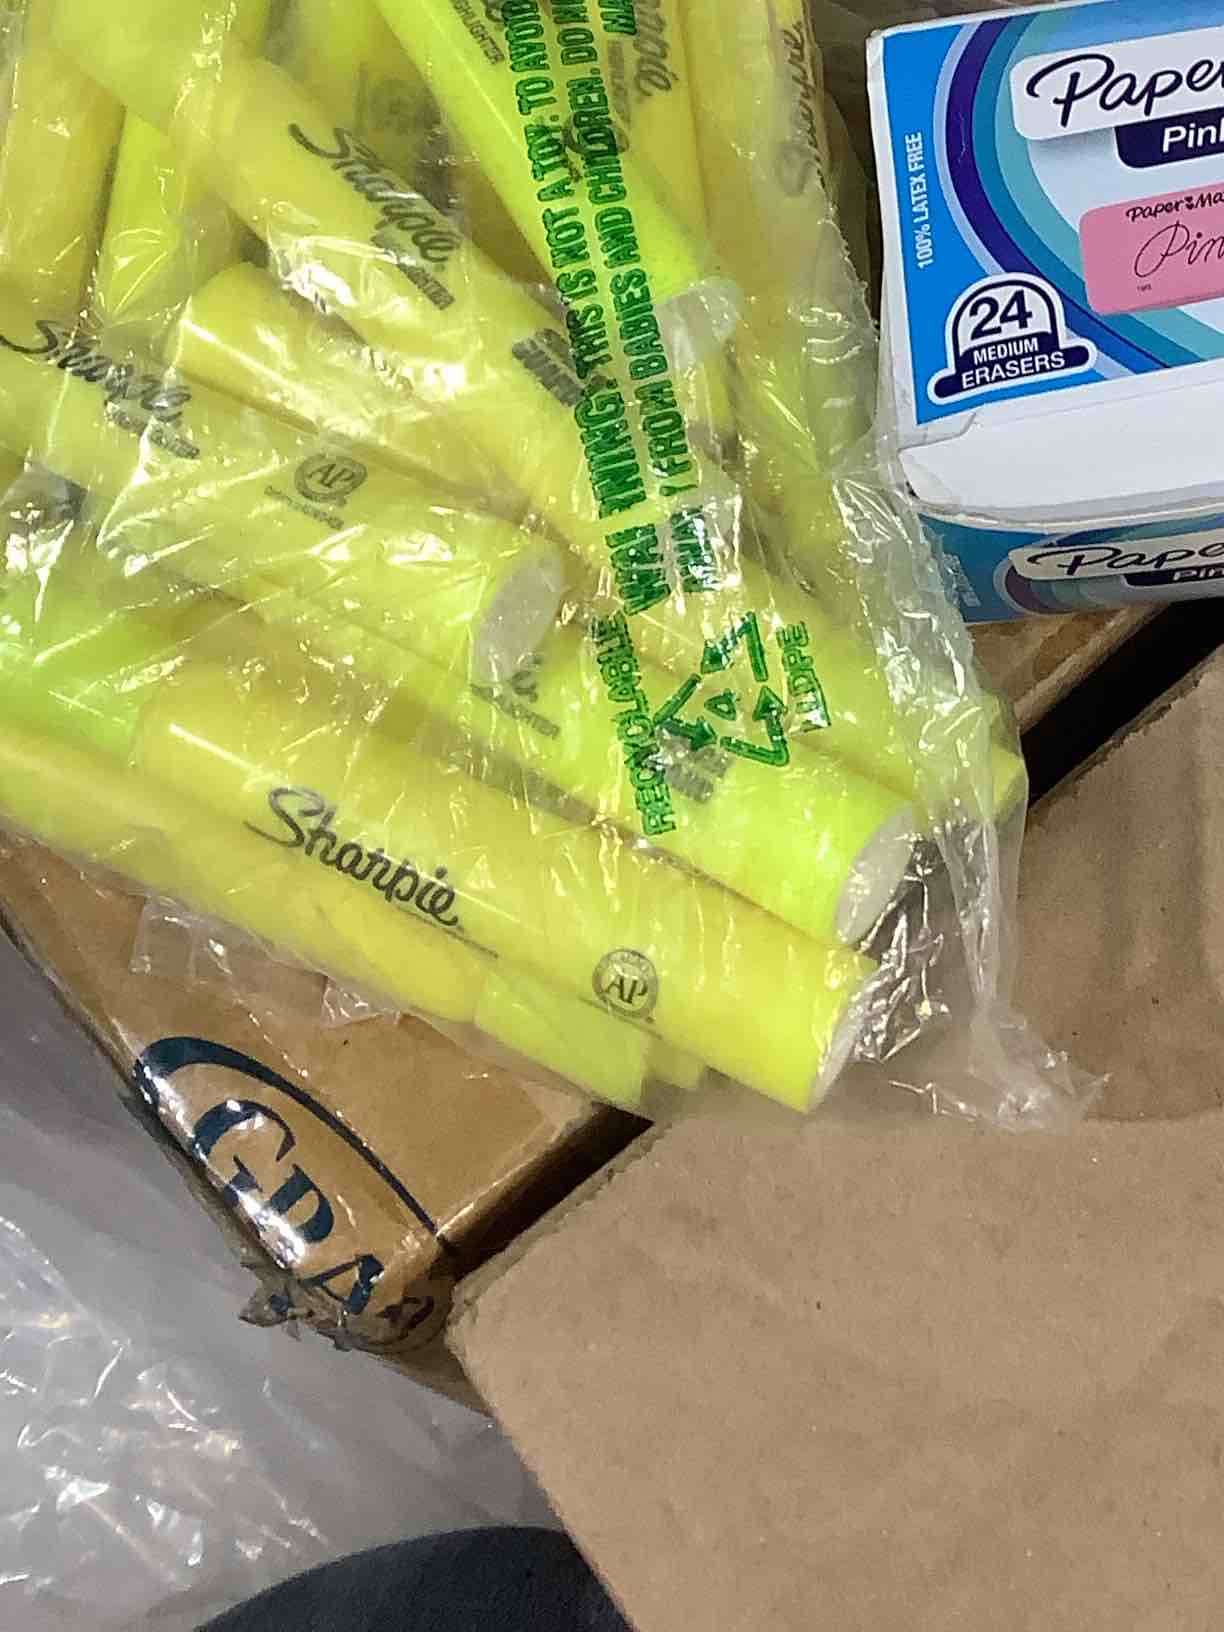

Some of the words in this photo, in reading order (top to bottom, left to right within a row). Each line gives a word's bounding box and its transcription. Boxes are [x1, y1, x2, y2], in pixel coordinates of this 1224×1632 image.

[556, 26, 599, 66] DO
[515, 75, 557, 116] TO
[565, 67, 628, 205] CHILDREN.
[904, 130, 926, 172] FREE
[287, 122, 466, 263] Sharpie
[536, 175, 575, 203] A
[908, 175, 933, 222] LATEX
[1125, 198, 1187, 223] Paper
[542, 205, 591, 269] NOT
[594, 205, 642, 269] AND
[914, 221, 935, 269] 100%
[555, 267, 598, 305] IS
[608, 267, 669, 381] BABIES
[967, 288, 1034, 342] 24
[566, 303, 613, 380] THIS
[972, 336, 1040, 366] MEDIUM
[960, 350, 1067, 391] ERASERS
[634, 378, 692, 477] FROM
[590, 610, 677, 836] RECYCLABLE
[703, 687, 741, 721] 4
[243, 785, 460, 927] Sharpie
[604, 974, 649, 1006] AP
